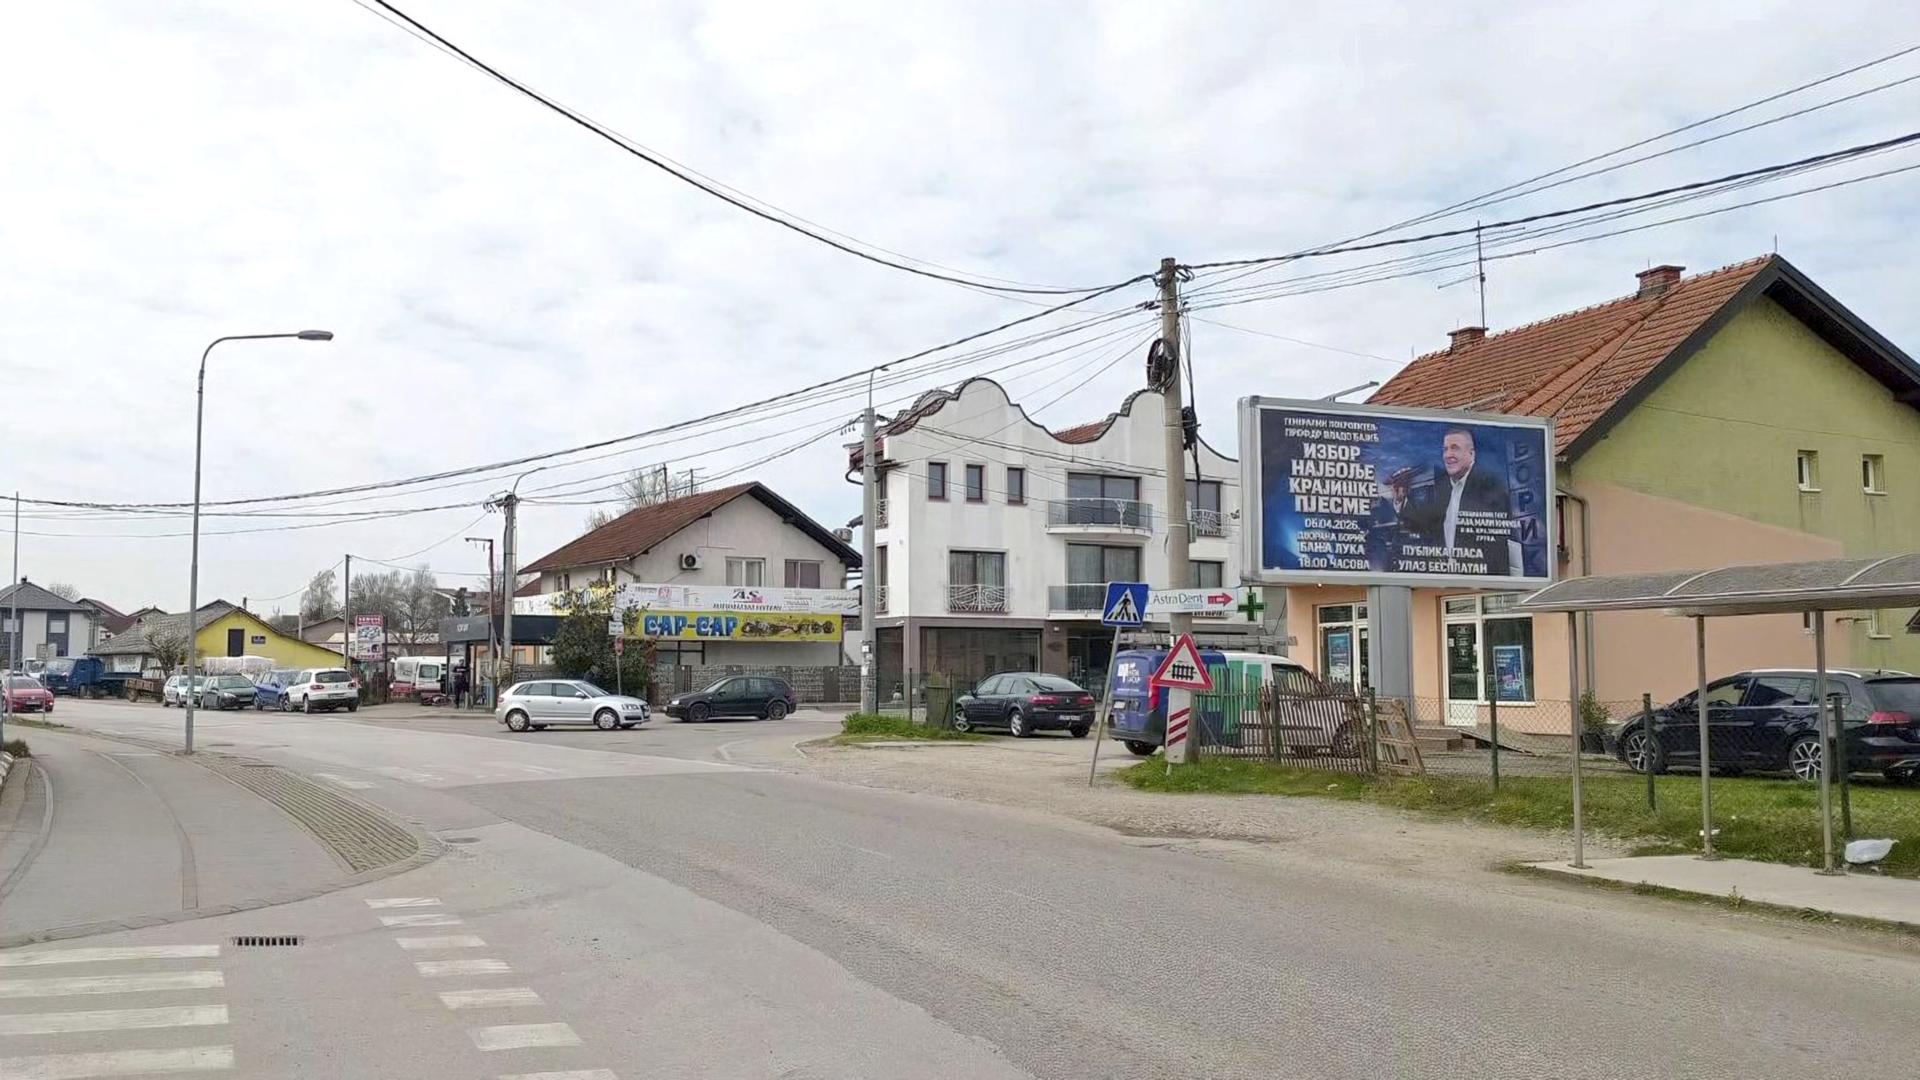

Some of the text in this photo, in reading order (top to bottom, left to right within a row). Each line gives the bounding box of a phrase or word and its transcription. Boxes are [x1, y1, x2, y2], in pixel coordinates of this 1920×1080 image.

[1303, 442, 1361, 461] ИЗБОР
[1291, 459, 1376, 480] НАЈБОЉЕ
[1289, 477, 1379, 498] КРАЈИШКЕ
[1295, 494, 1372, 516] ПЈЕСМЕ
[1300, 541, 1365, 555] БАЊА ЛУКА
[1402, 545, 1484, 559] ПУБЛИКА ГЛАСА
[1299, 556, 1370, 570] 18.00 ЧАСОВА
[1398, 559, 1488, 574] УЛАЗ БЕСПЛАТАН
